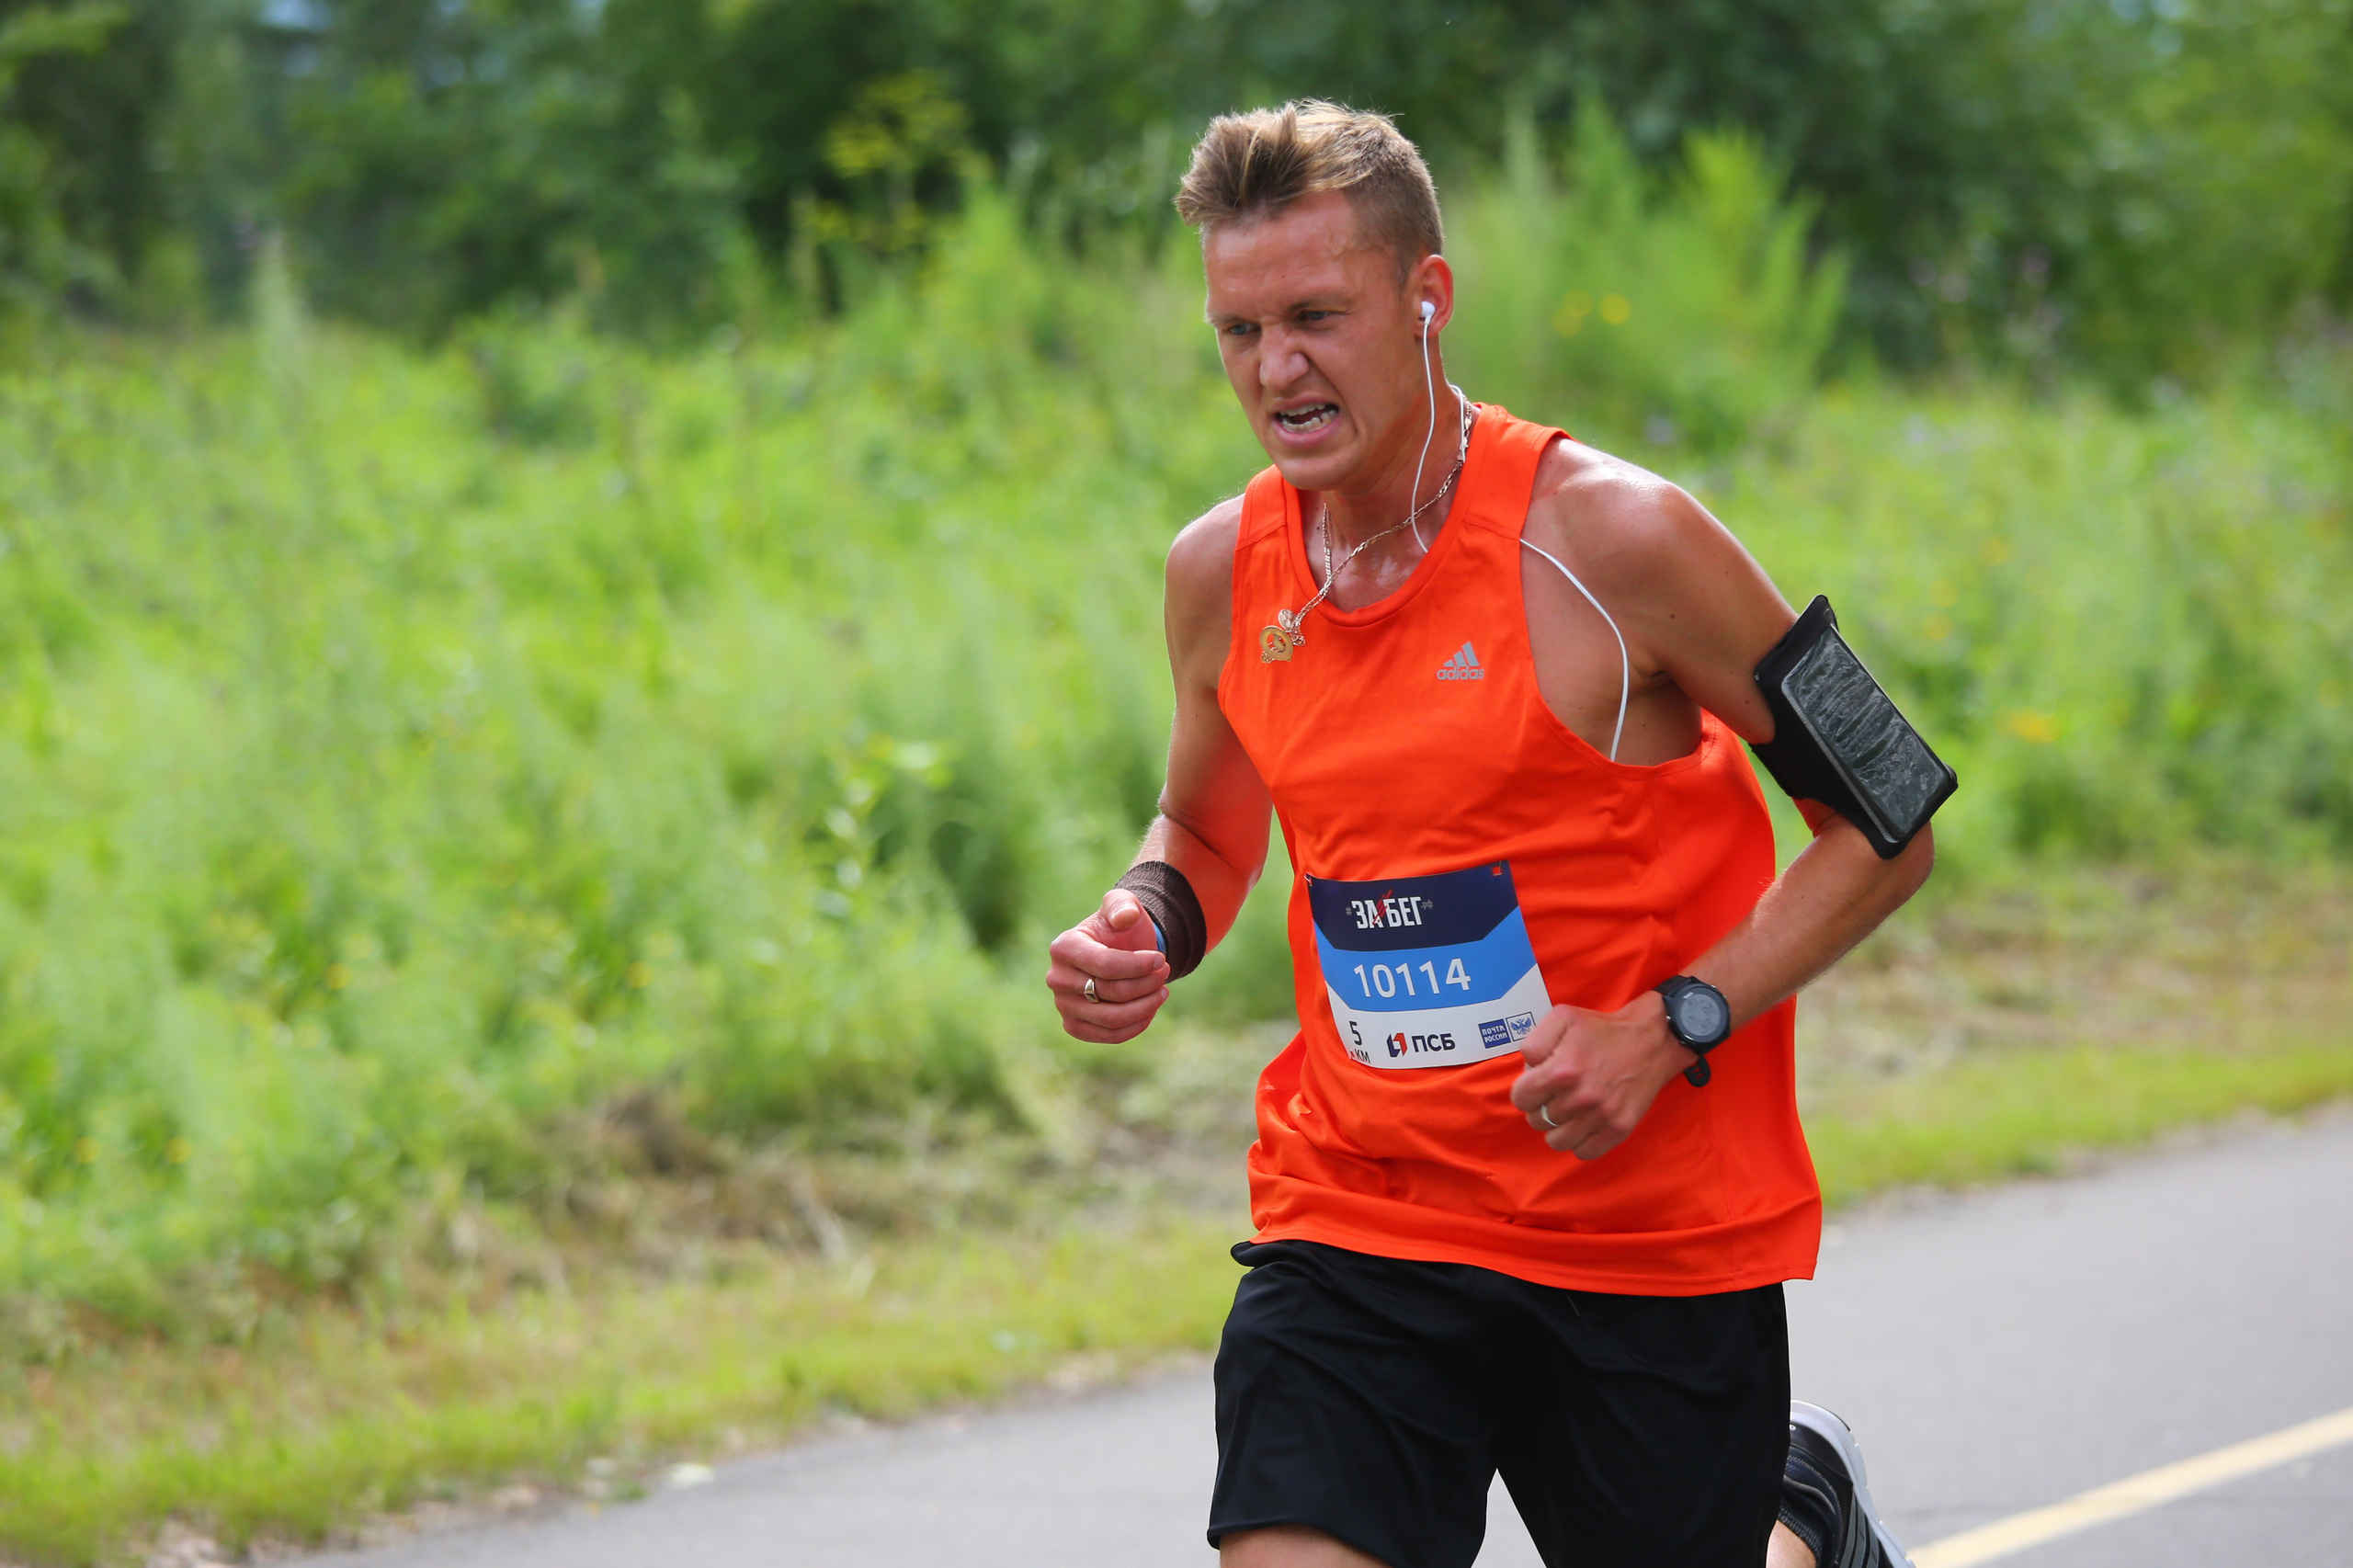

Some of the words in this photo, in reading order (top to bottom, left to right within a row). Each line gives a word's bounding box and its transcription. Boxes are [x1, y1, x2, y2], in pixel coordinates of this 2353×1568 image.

[1437, 665, 1484, 680] adidas
[1353, 958, 1472, 998] 10114
[1349, 1020, 1362, 1046] 5
[1482, 1025, 1506, 1036] ПОЧТА
[1484, 1032, 1508, 1043] РОССИИ
[1411, 1033, 1456, 1052] ПСБ
